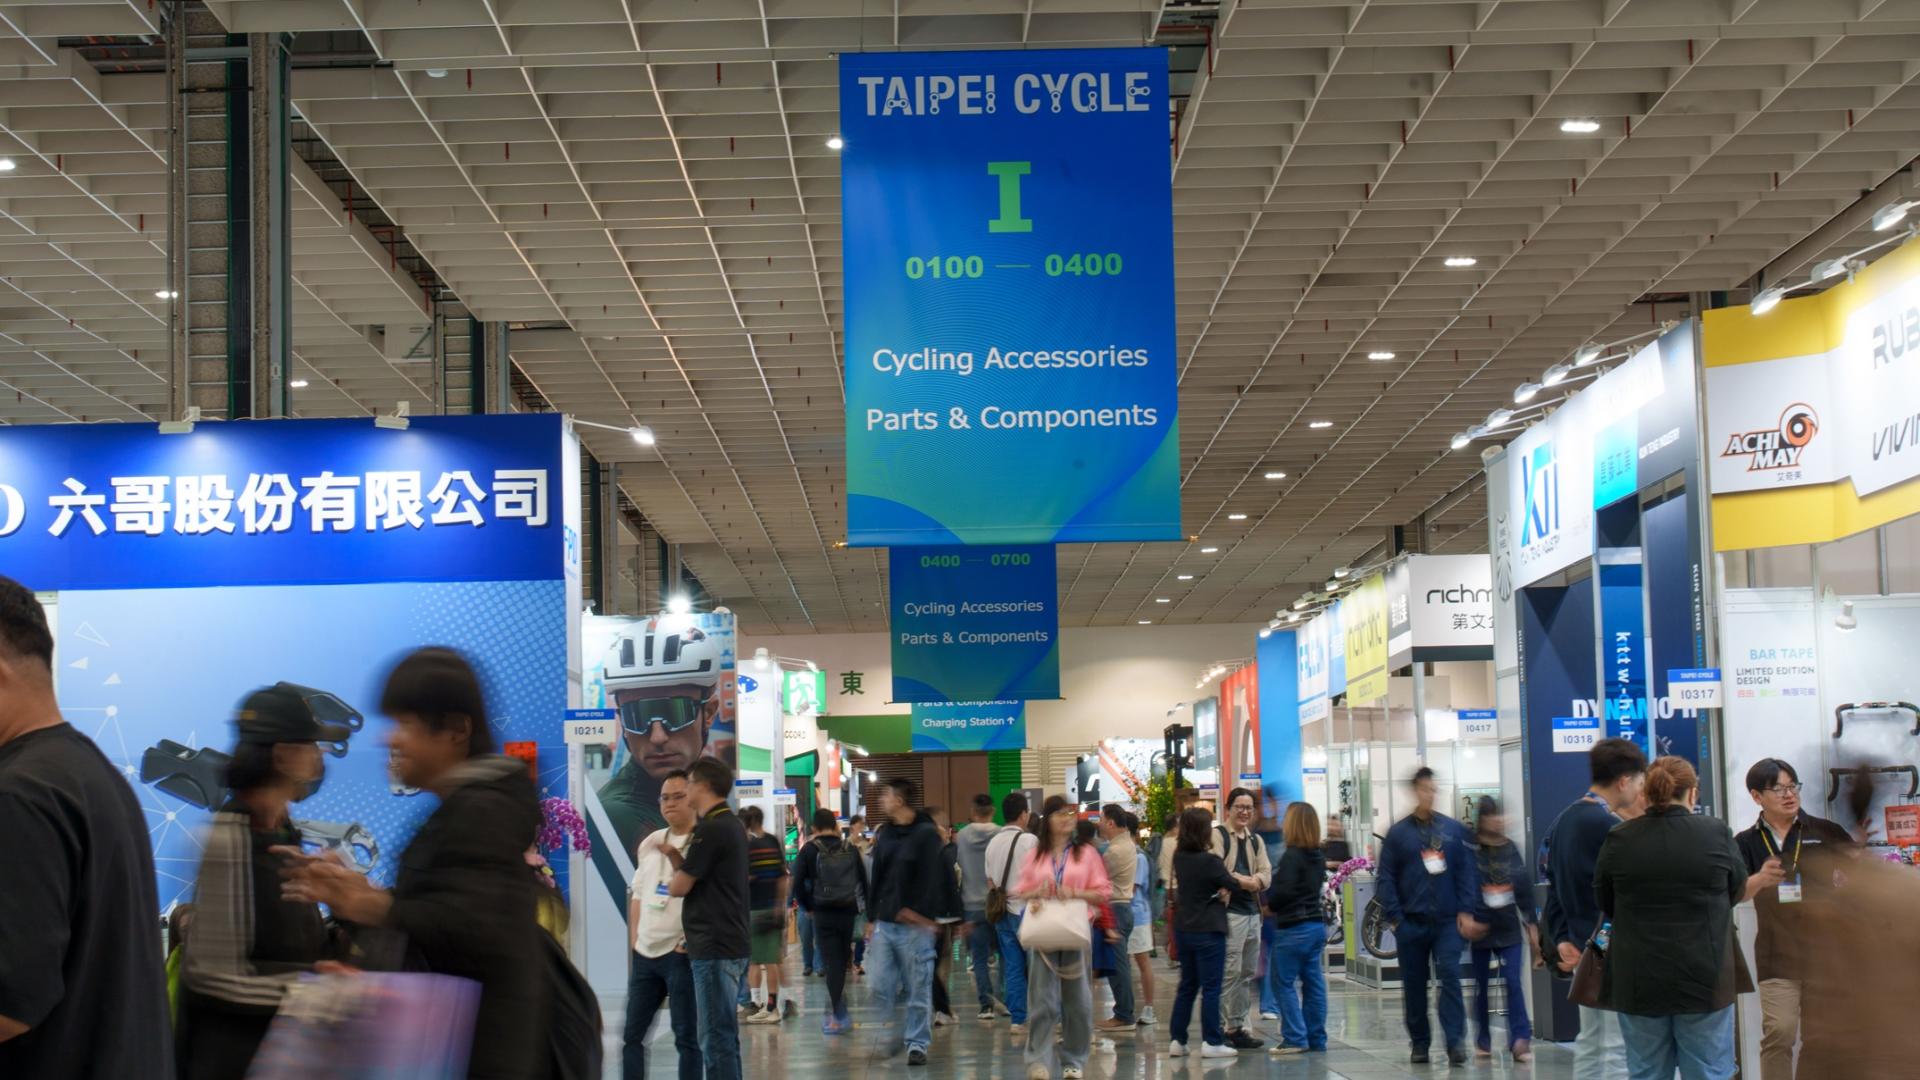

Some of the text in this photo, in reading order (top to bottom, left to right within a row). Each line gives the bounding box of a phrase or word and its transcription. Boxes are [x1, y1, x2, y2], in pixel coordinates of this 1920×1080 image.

[858, 72, 1151, 116] TAIPEI CYCLE
[987, 161, 1033, 233] I
[906, 255, 984, 280] 0100
[1045, 253, 1123, 276] 0400
[872, 345, 1148, 375] Cycling Accessories
[866, 404, 1158, 432] Parts & Components
[1722, 431, 1781, 456] ACHI
[1749, 447, 1802, 471] MAY
[48, 469, 549, 536] 六哥股份有限公司
[921, 555, 960, 567] 0400
[991, 553, 1031, 566] 0700
[904, 600, 1044, 617] Cycling Accessories
[901, 630, 1048, 646] Parts & Components
[1750, 648, 1814, 660] BAR TAPE
[840, 671, 864, 695] 東
[1736, 666, 1815, 676] LIMITED EDITION
[1737, 676, 1770, 685] DESIGN
[922, 717, 1005, 728] Charging Station
